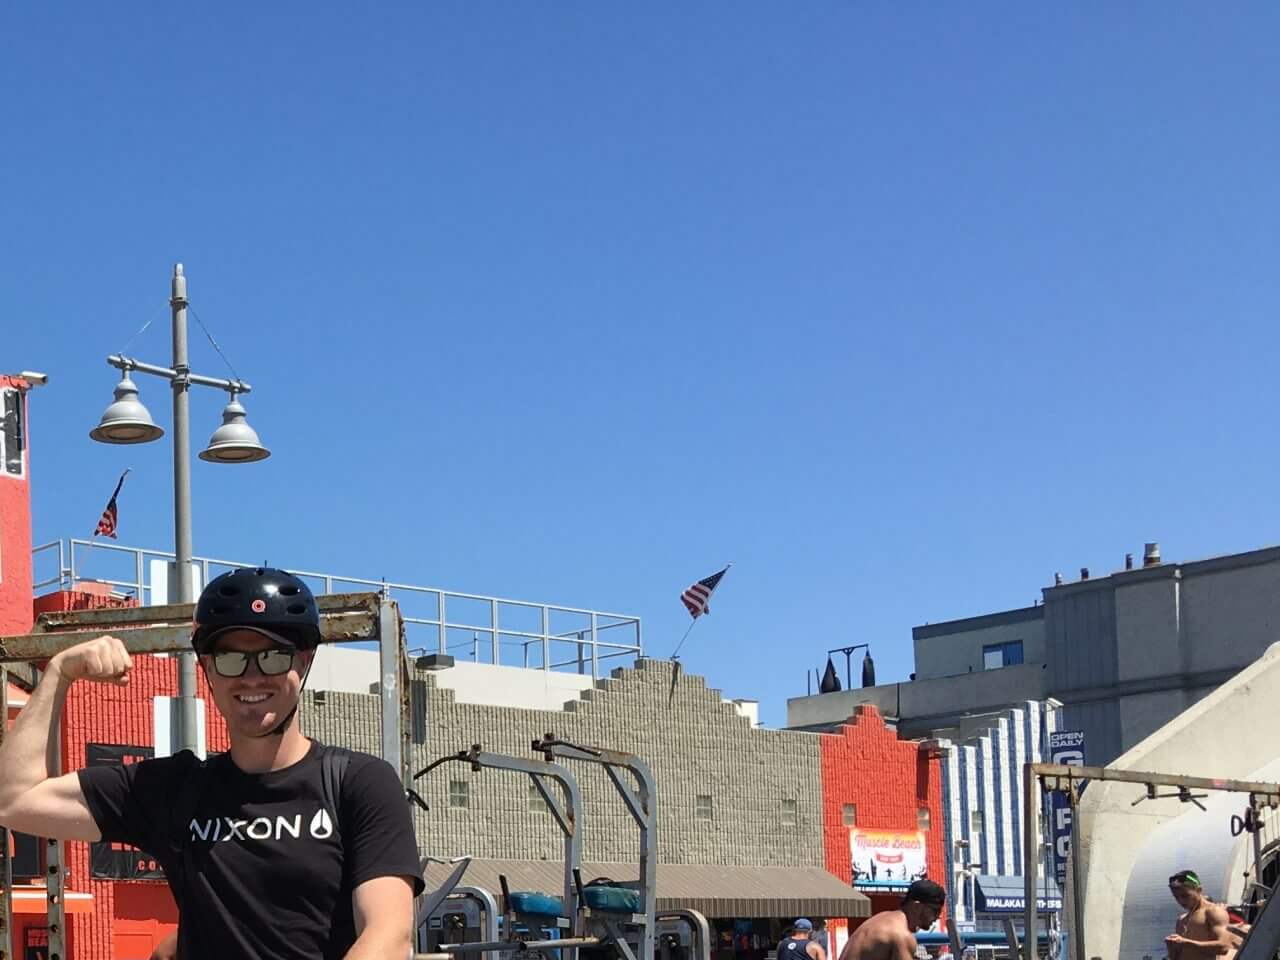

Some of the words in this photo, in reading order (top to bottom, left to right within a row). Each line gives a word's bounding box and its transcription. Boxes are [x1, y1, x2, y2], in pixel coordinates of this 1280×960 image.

[1051, 732, 1083, 741] OPEN
[1051, 739, 1083, 747] DAILY
[189, 814, 302, 841] NIXON
[986, 899, 1021, 908] MALAKA
